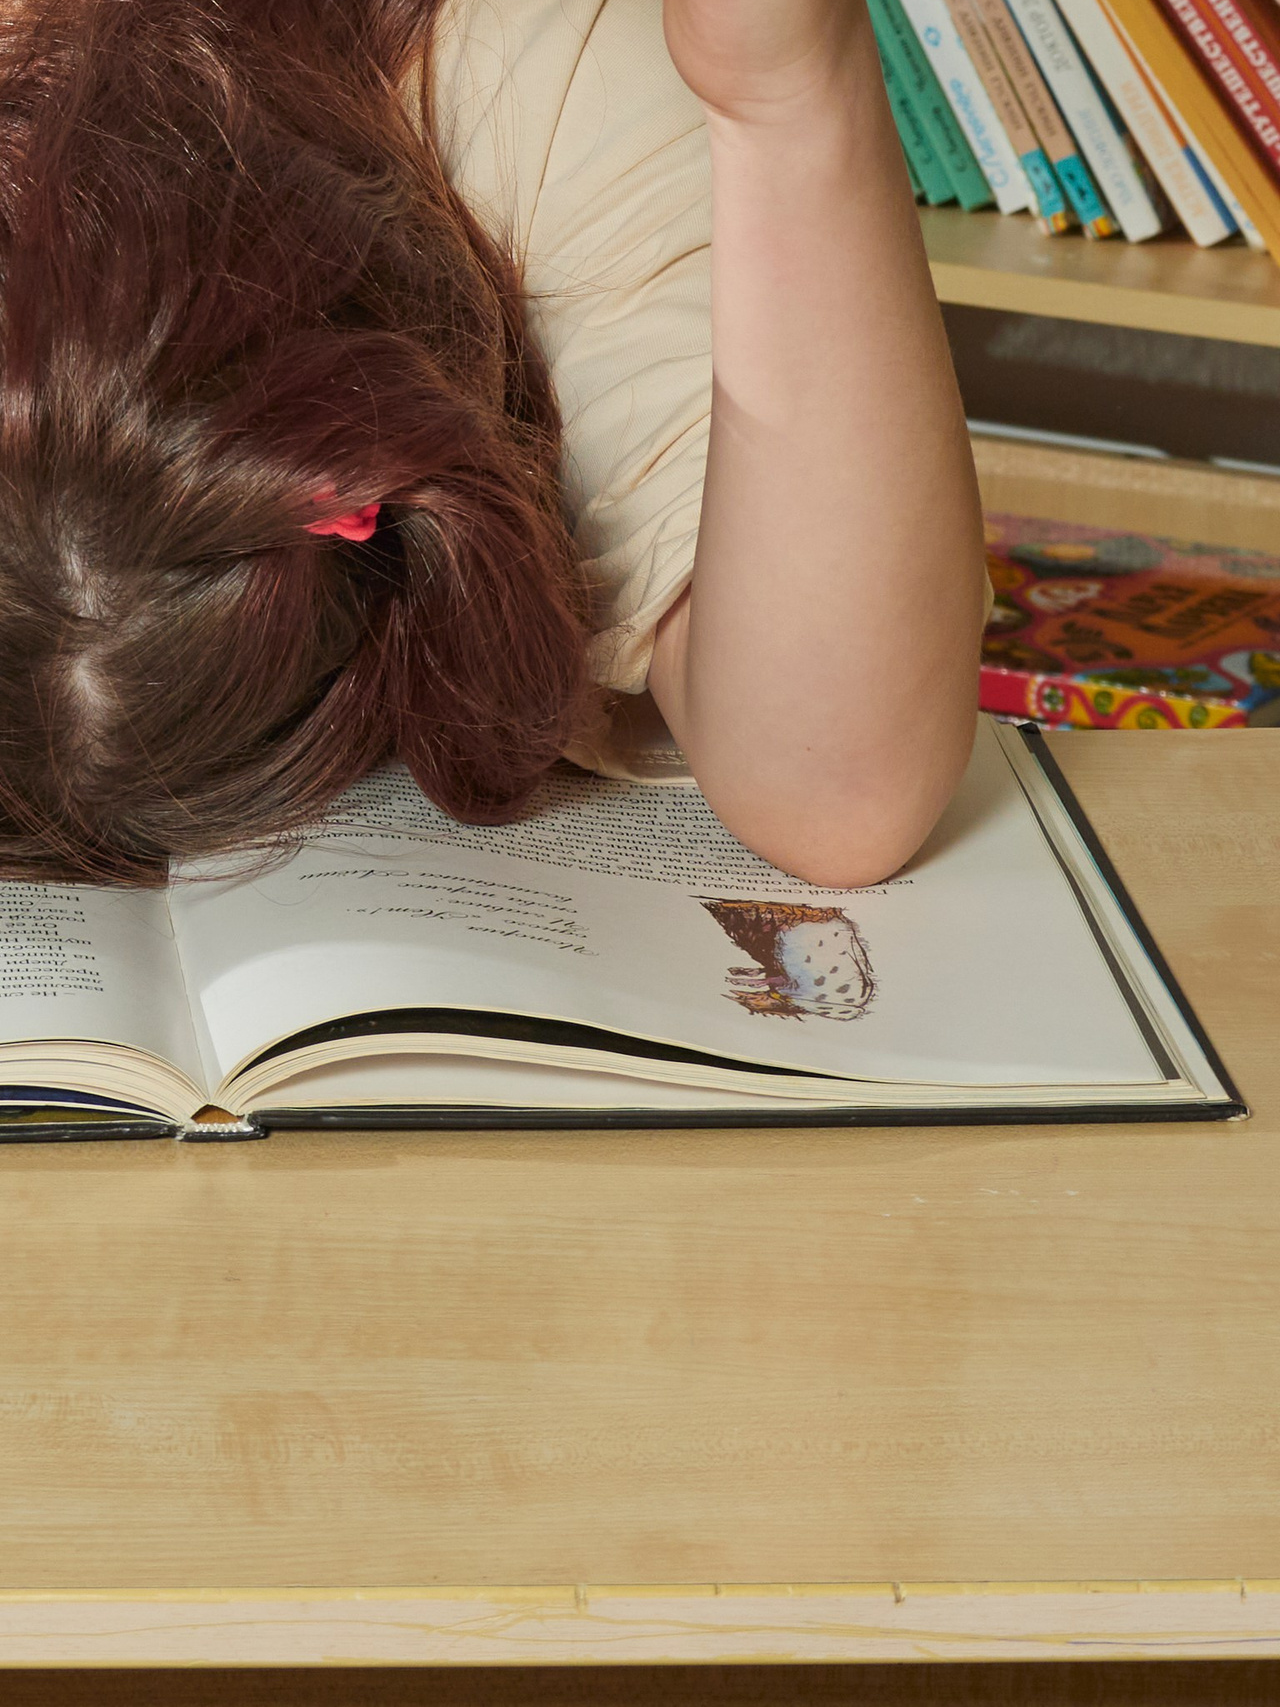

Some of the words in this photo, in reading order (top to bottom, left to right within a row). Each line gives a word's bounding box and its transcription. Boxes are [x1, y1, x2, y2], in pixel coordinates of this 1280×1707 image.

[1027, 5, 1074, 75] ДОКТОР
[397, 883, 496, 898] термос
[417, 873, 572, 902] волшебника
[504, 920, 588, 938] одного
[466, 926, 599, 956] История
[60, 976, 102, 984] лась
